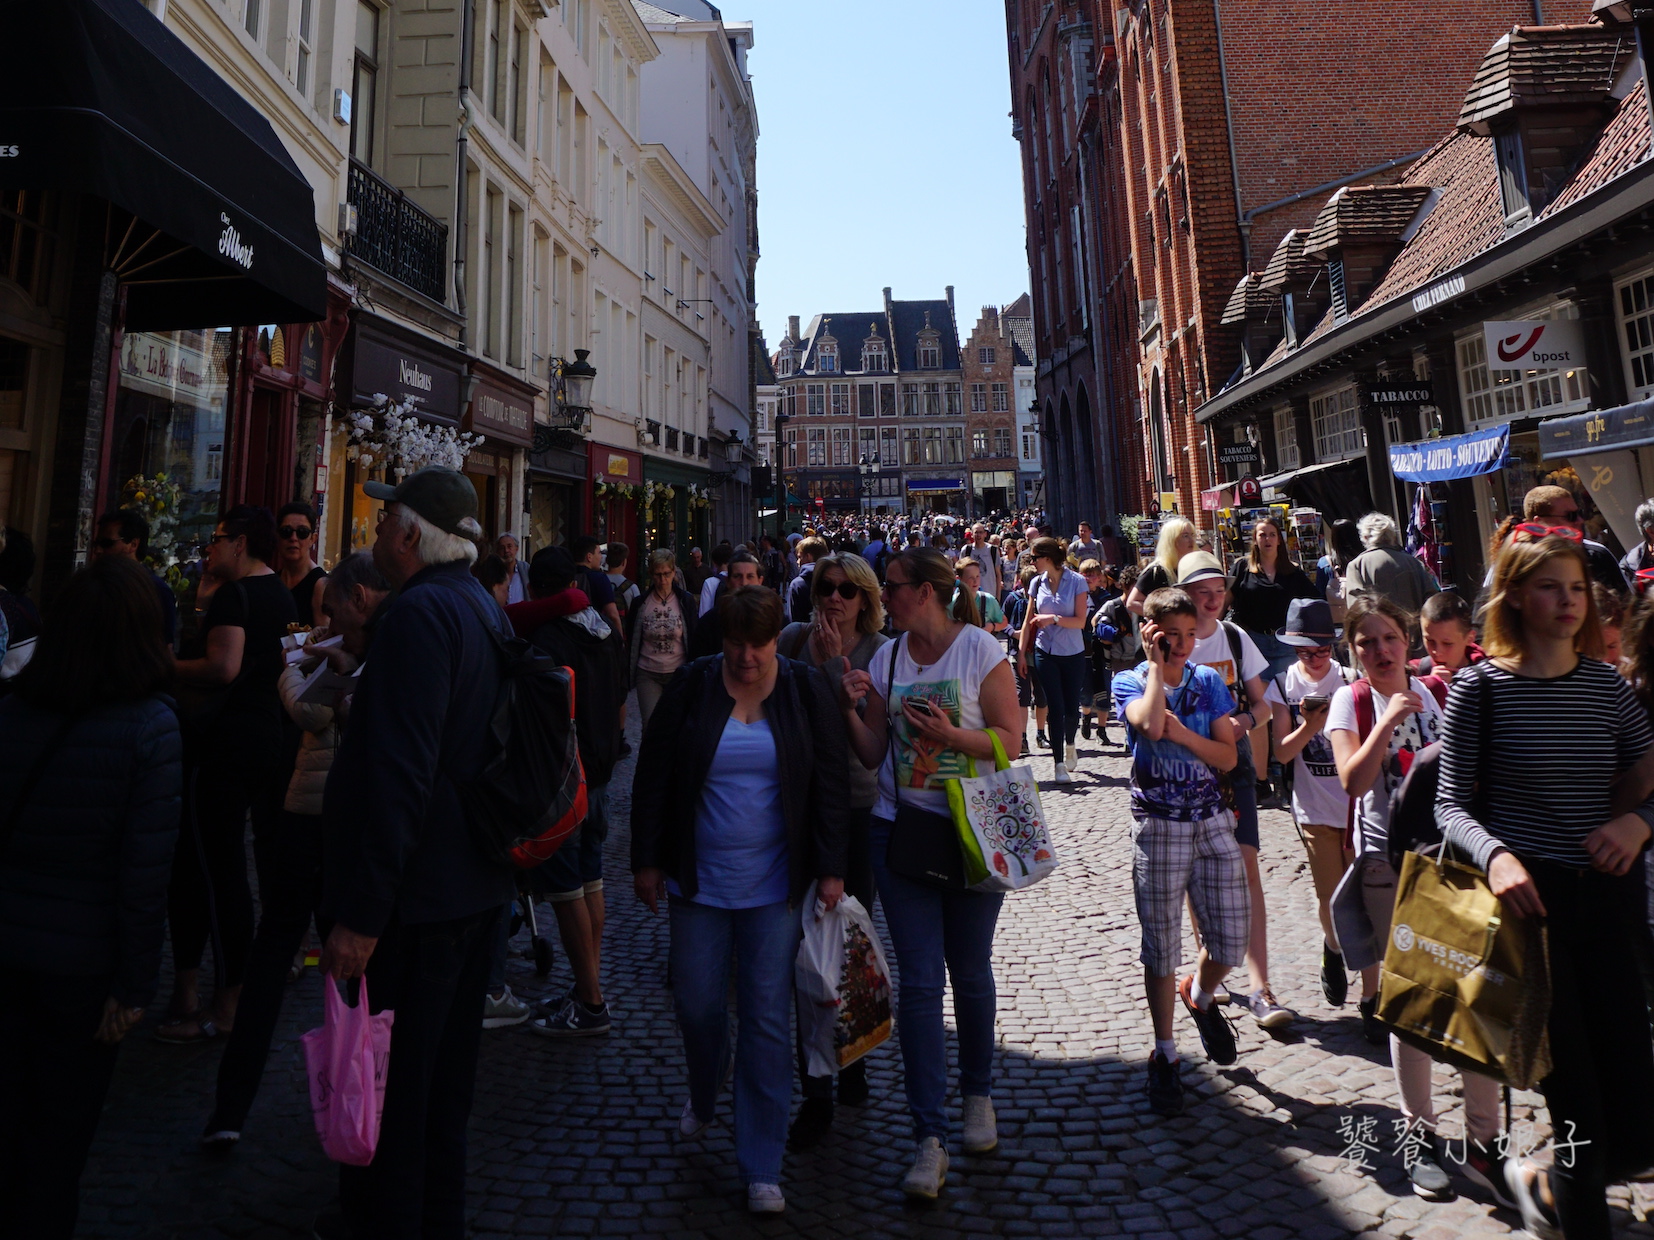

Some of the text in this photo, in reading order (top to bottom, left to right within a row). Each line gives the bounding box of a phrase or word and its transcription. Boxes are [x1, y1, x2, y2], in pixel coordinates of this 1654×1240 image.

[219, 225, 254, 270] Albert
[1412, 273, 1466, 313] CHEZ FERNAND
[1532, 351, 1570, 364] bpost
[399, 359, 432, 392] Neuhaus
[1371, 390, 1430, 403] TABACCO
[1220, 453, 1258, 464] SOUVENIERS
[1223, 446, 1252, 455] TABACCO
[1427, 447, 1452, 470] LOTTO
[1416, 937, 1447, 958] YVES
